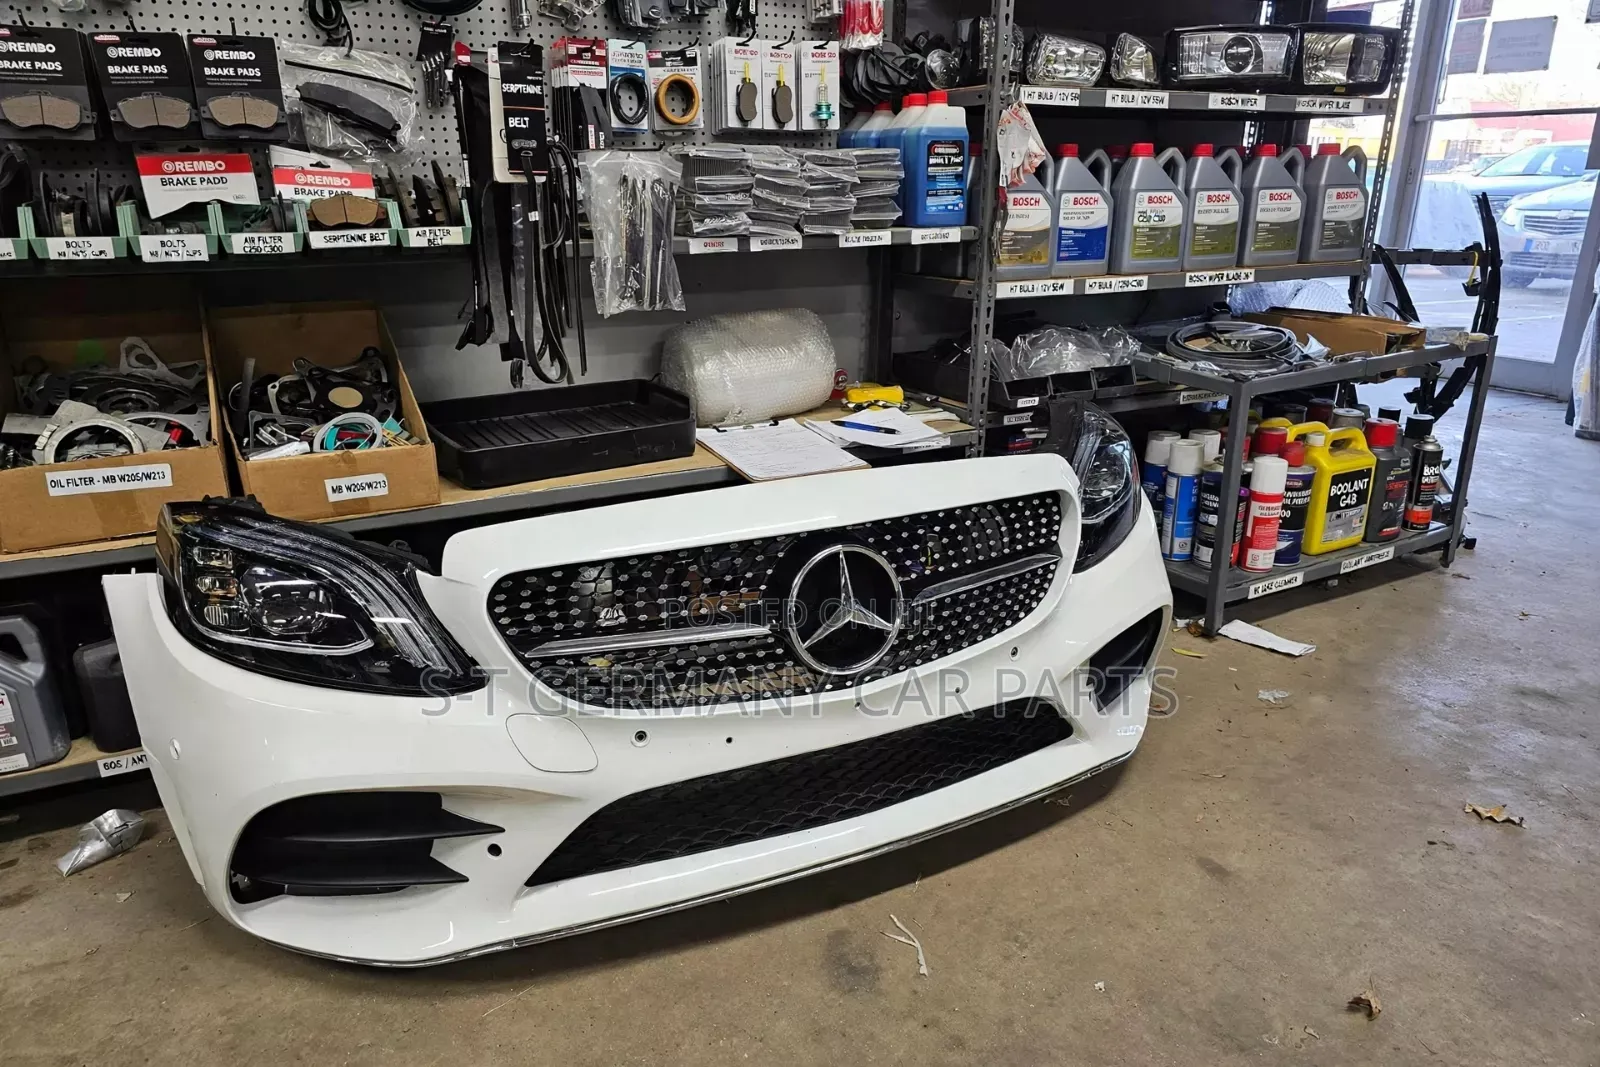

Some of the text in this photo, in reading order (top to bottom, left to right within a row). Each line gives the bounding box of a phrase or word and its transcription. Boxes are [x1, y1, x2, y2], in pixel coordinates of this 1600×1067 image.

[34, 61, 63, 71] PADS
[107, 64, 168, 74] BRAKE PADS
[203, 67, 262, 77] BRAKE PADS
[508, 117, 530, 128] BELT
[160, 176, 228, 187] BRAKE PADD
[293, 187, 326, 198] BRAKE
[1268, 193, 1293, 202] BOSCH
[1335, 191, 1359, 200] BOSCH
[1012, 197, 1041, 207] BOSCH
[1072, 197, 1099, 206] BOSCH
[1147, 195, 1173, 205] BOSCH
[1206, 194, 1231, 204] BOSCH
[64, 240, 92, 249] BOLTS
[160, 239, 187, 248] BOLTS
[49, 479, 66, 489] OIL
[66, 476, 96, 488] FILTER
[102, 474, 117, 485] MB
[331, 484, 344, 494] MB
[1329, 477, 1370, 497] BOOLANT
